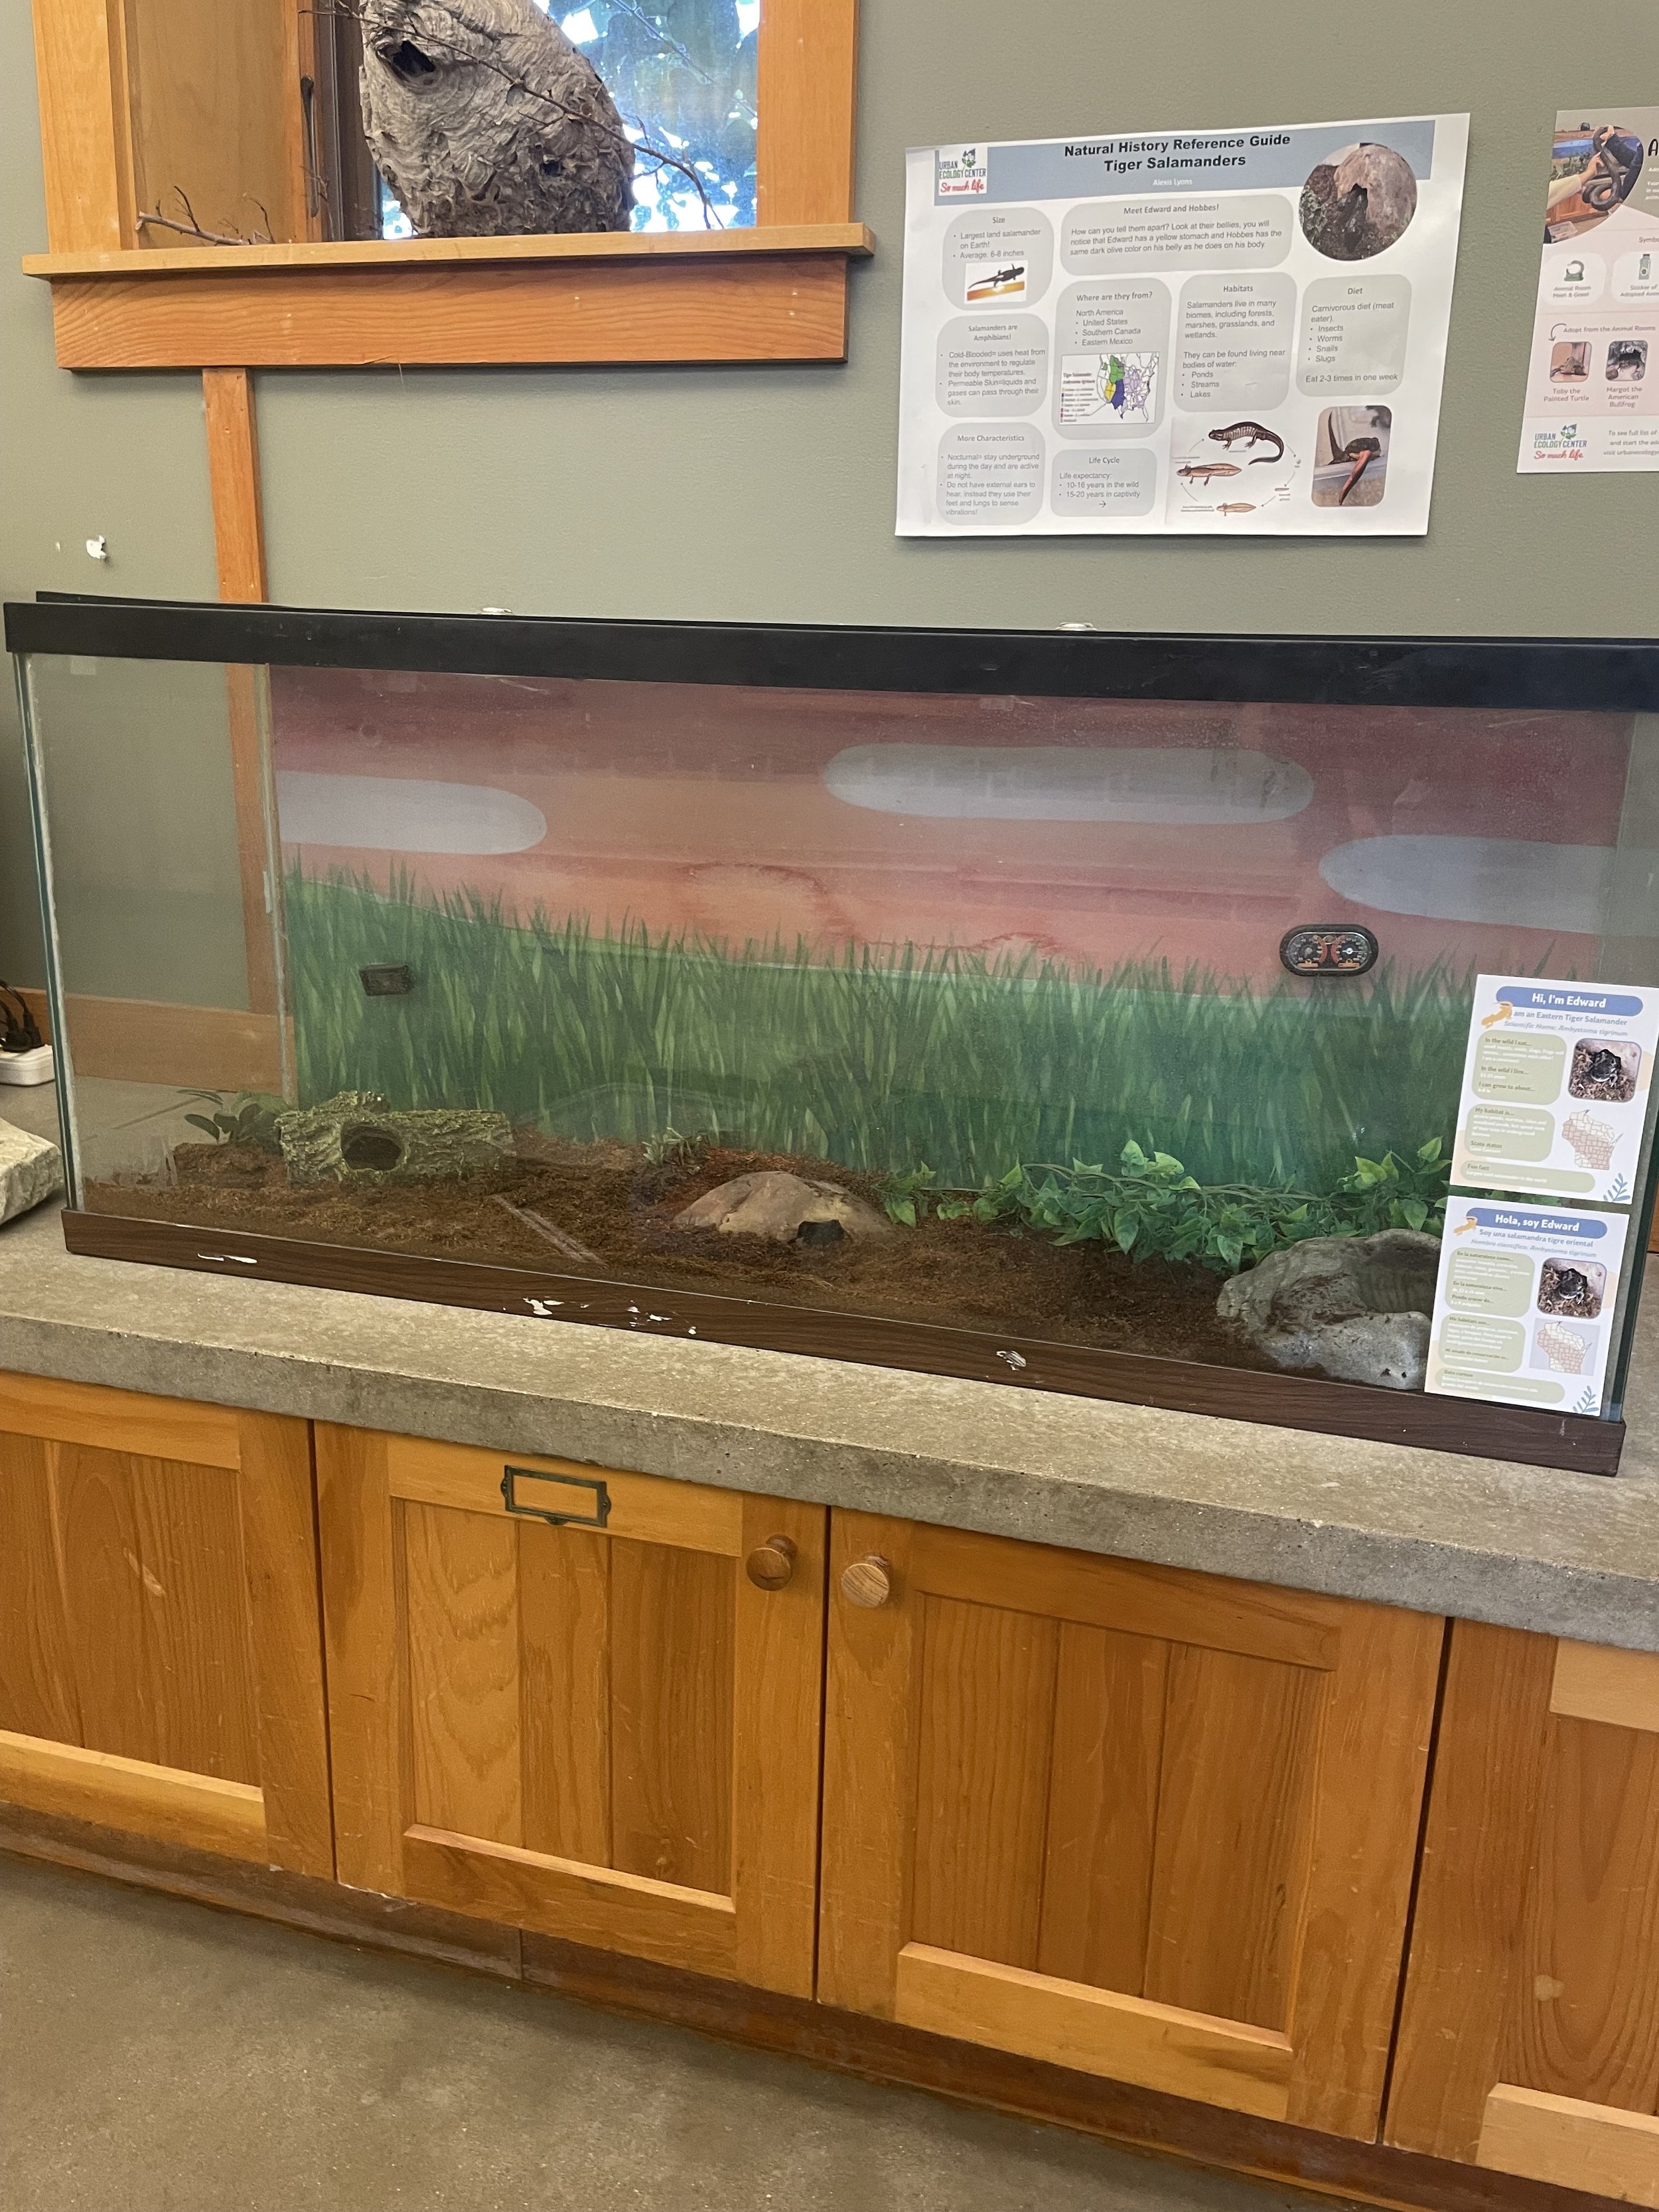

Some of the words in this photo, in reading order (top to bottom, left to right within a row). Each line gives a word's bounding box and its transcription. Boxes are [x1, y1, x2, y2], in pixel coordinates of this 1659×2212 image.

[1064, 143, 1114, 156] Natural
[1118, 141, 1169, 153] History
[1173, 139, 1244, 149] Reference
[1250, 134, 1290, 146] Guide
[939, 161, 958, 170] URBAN
[1104, 160, 1142, 173] Tiger
[1147, 155, 1246, 169] Salamanders
[940, 170, 964, 179] ECOLOGY
[965, 168, 986, 178] CENTER
[940, 182, 951, 192] So
[952, 181, 970, 191] much
[971, 179, 984, 193] life
[1147, 223, 1170, 232] apart?
[960, 232, 985, 240] Largest
[1155, 234, 1178, 242] yellow
[1183, 351, 1200, 360] They
[1534, 450, 1546, 459] So
[1547, 450, 1567, 459] much
[1568, 449, 1583, 461] life
[1532, 993, 1546, 1004] Hi,
[1548, 994, 1564, 1004] I'm
[1566, 995, 1607, 1007] Edward
[1536, 1011, 1563, 1020] Eastern
[1565, 1013, 1583, 1023] Tiger
[1584, 1015, 1627, 1025] Salamander
[1495, 1214, 1521, 1226] Hola,
[1522, 1219, 1540, 1228] soy
[1541, 1219, 1579, 1231] Edward
